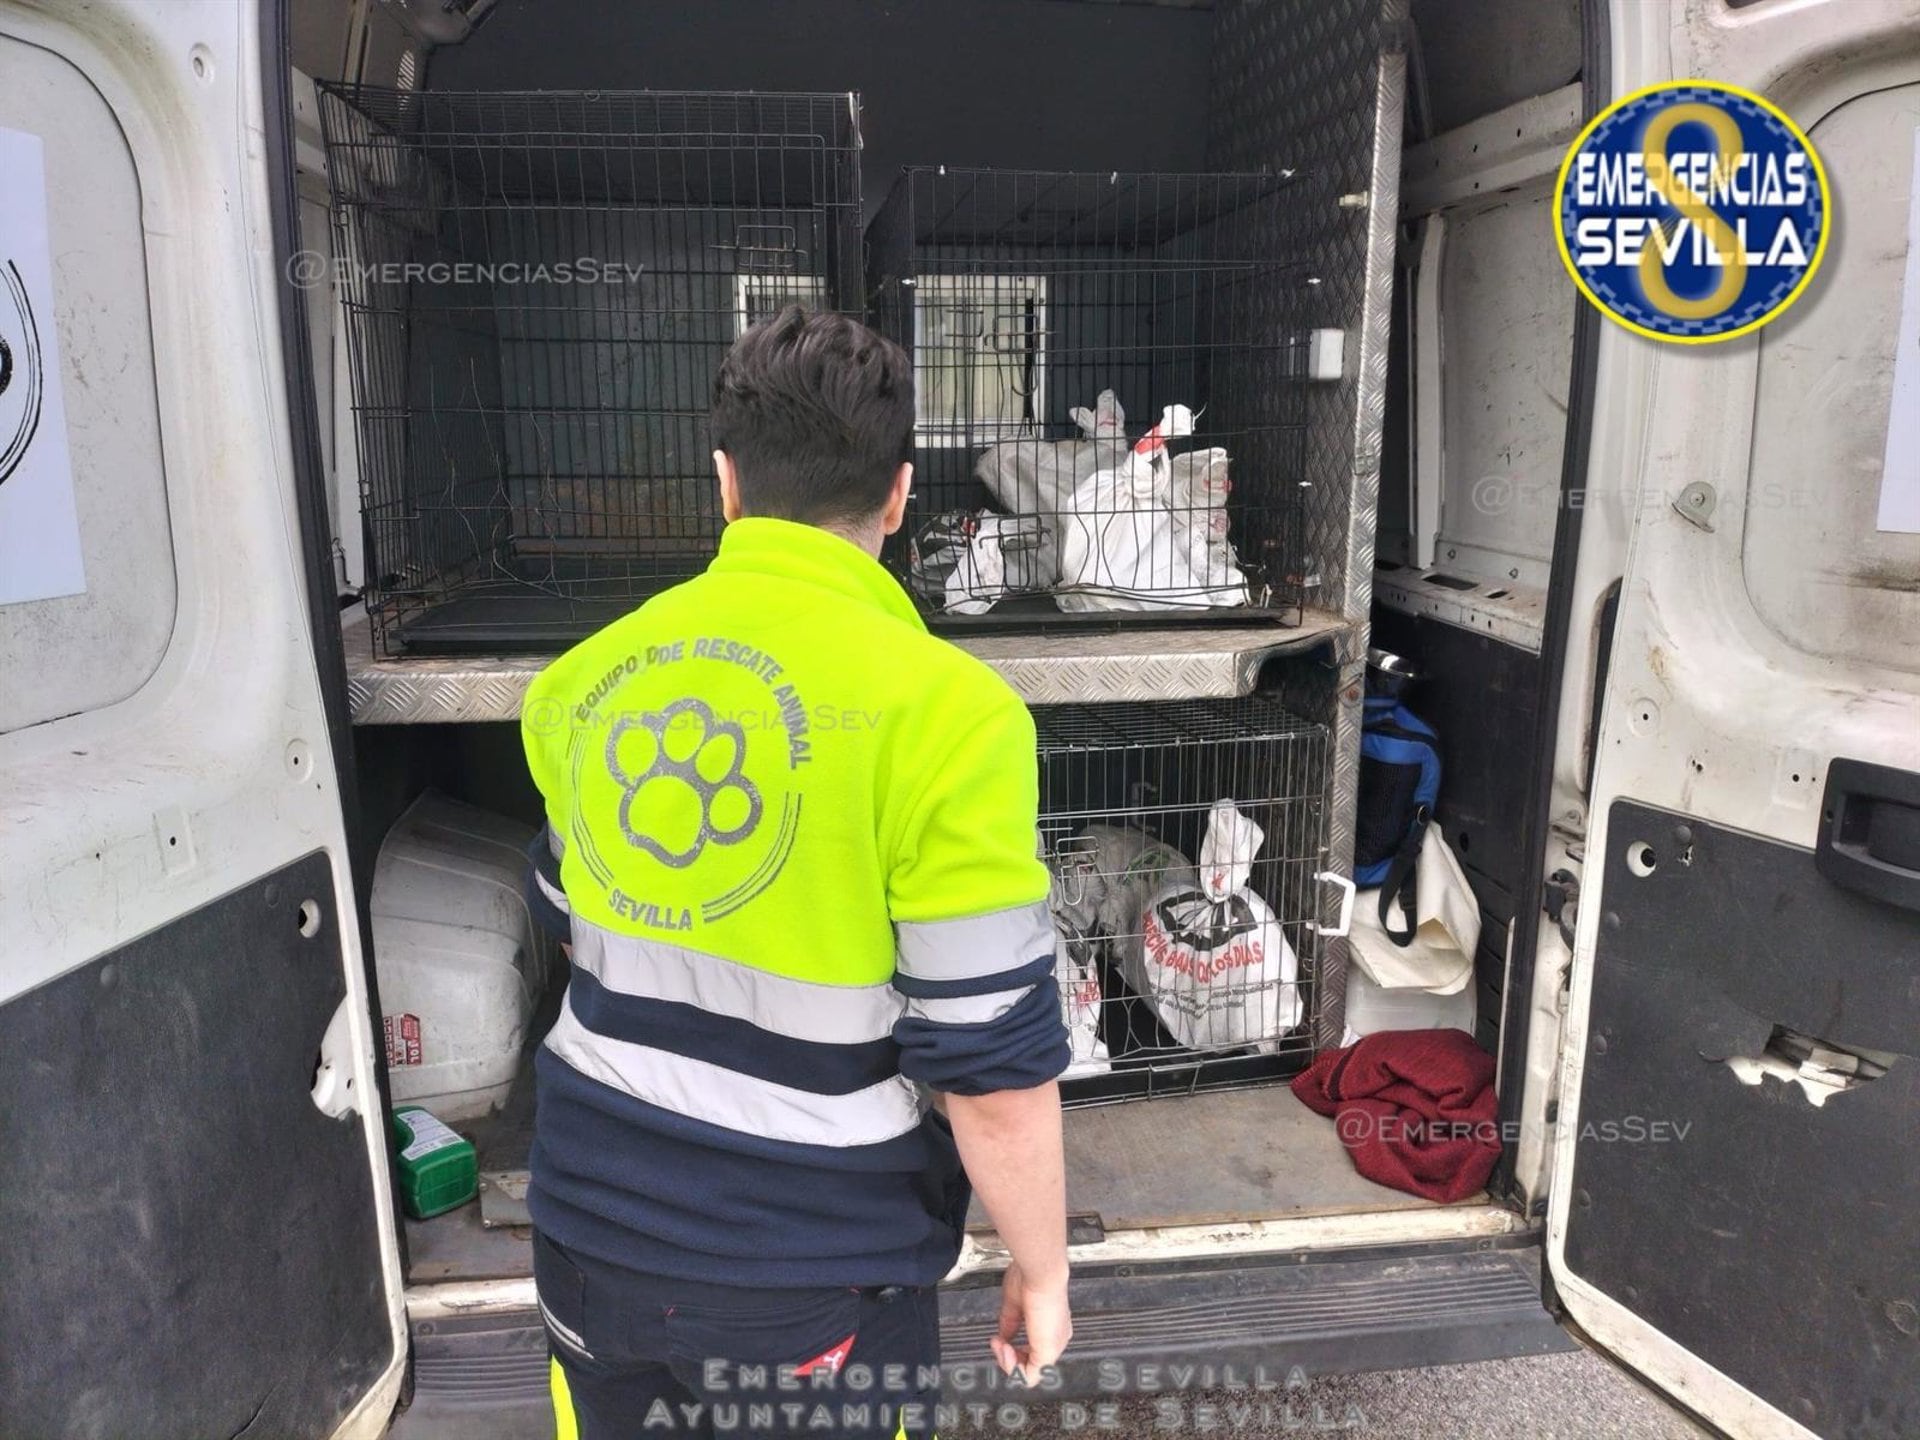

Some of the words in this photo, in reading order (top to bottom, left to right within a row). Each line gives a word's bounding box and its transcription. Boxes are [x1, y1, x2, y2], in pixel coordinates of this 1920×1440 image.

[576, 655, 637, 723] EQUIPO
[693, 637, 784, 685] RESCATE
[773, 684, 812, 770] ANIMAL
[608, 888, 692, 931] SEVILLA
